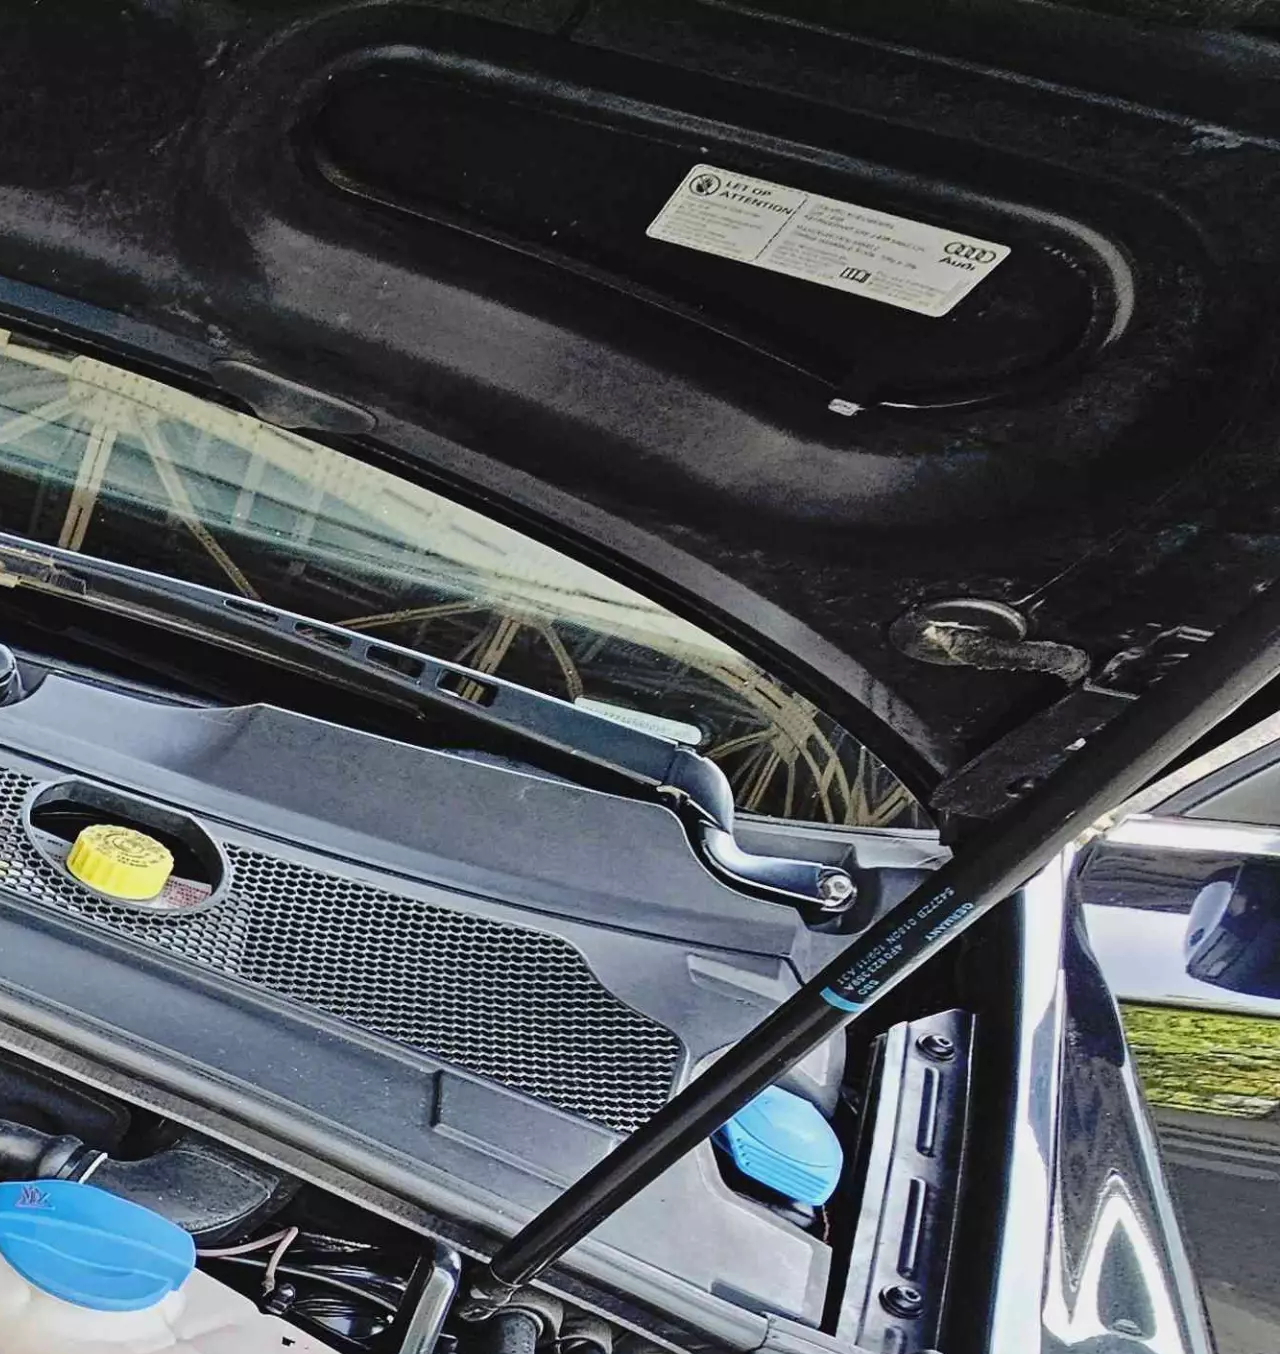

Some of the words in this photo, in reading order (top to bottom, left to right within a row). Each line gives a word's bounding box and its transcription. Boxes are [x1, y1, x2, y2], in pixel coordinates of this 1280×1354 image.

[718, 189, 794, 215] ATTENTION
[750, 186, 773, 198] OP
[937, 254, 980, 272] Audi
[924, 899, 974, 942] GERMANY
